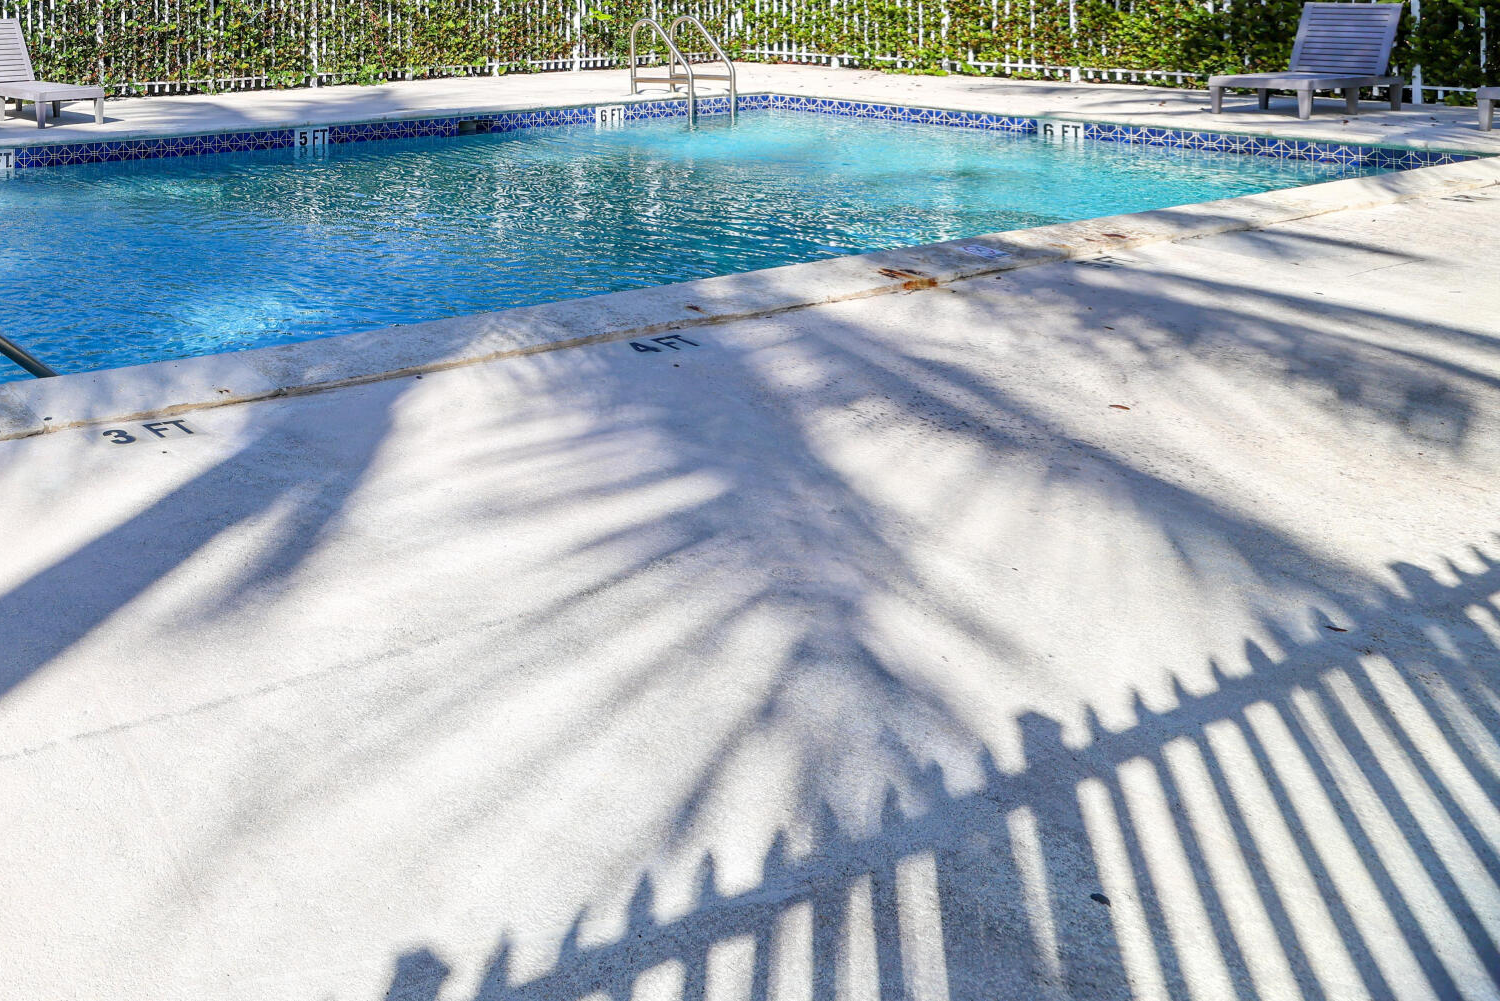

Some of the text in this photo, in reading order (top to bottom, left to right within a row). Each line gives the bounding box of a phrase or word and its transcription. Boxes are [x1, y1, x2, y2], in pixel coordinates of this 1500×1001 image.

[600, 109, 607, 122] 6
[299, 129, 328, 146] 5 FT
[1043, 123, 1080, 138] 6 FT
[629, 334, 700, 352] 4 FT
[102, 419, 194, 444] 3 FT
